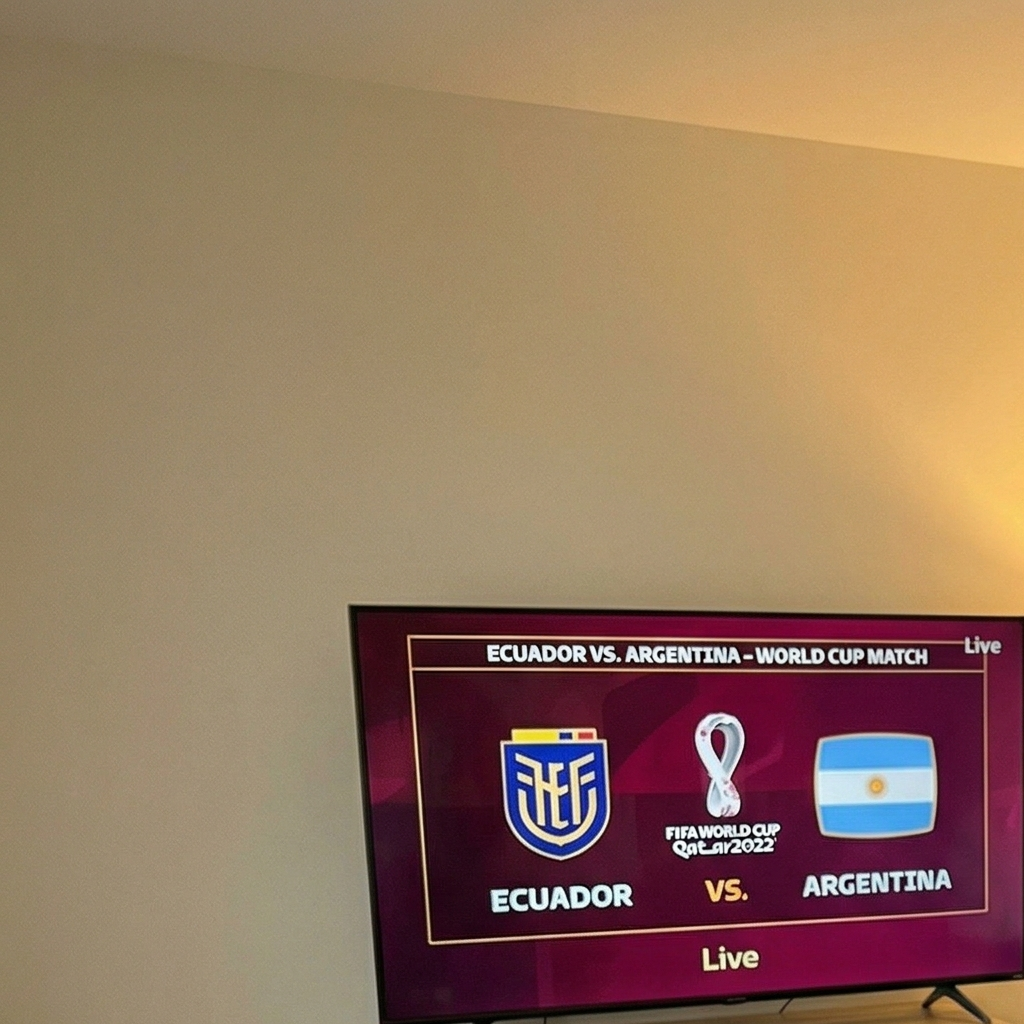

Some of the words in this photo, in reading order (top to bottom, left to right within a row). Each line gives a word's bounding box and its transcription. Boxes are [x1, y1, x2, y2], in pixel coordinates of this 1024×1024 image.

[486, 645, 587, 663] ECUADOR
[589, 645, 622, 663] VS.
[625, 646, 741, 664] ARGENTINA
[755, 647, 825, 664] WORLD
[828, 648, 865, 664] CUP
[867, 649, 928, 665] MATCH
[964, 636, 1002, 655] Live
[665, 826, 698, 840] FIFA
[698, 824, 752, 839] WORLD
[752, 823, 781, 838] CUP
[704, 878, 748, 903] VS.
[802, 868, 953, 898] ARGENTINA
[490, 883, 633, 913] ECUADOR
[702, 946, 760, 971] Live
